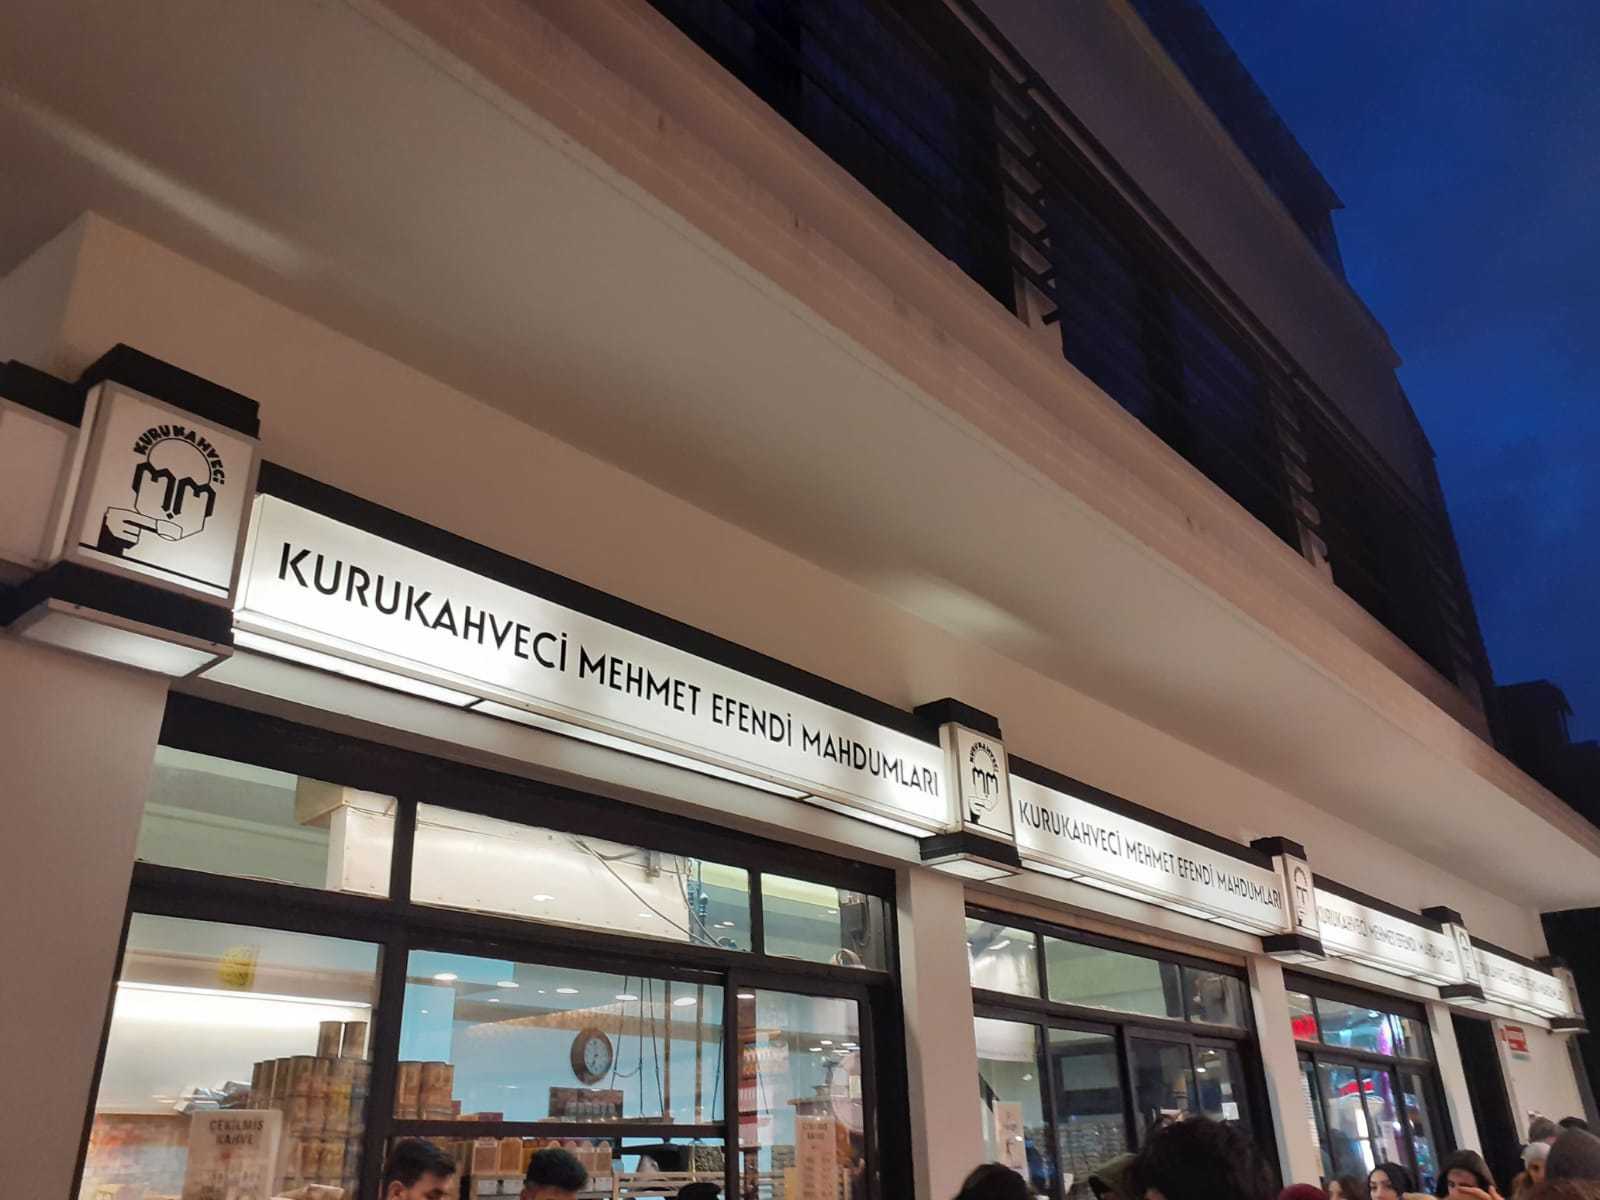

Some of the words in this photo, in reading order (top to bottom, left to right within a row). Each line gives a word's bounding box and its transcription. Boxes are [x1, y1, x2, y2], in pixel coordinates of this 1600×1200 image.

[278, 542, 567, 672] KURUKAHVECİ
[579, 645, 700, 715] MEHMET
[712, 693, 792, 746] EFENDİ
[801, 724, 939, 797] MAHDUMLARI
[1018, 799, 1122, 857] KURUKAHVECİ
[1125, 837, 1175, 875] MEHMET
[1177, 856, 1215, 887] EFENDİ
[1217, 871, 1282, 909] MAHDUMLARI
